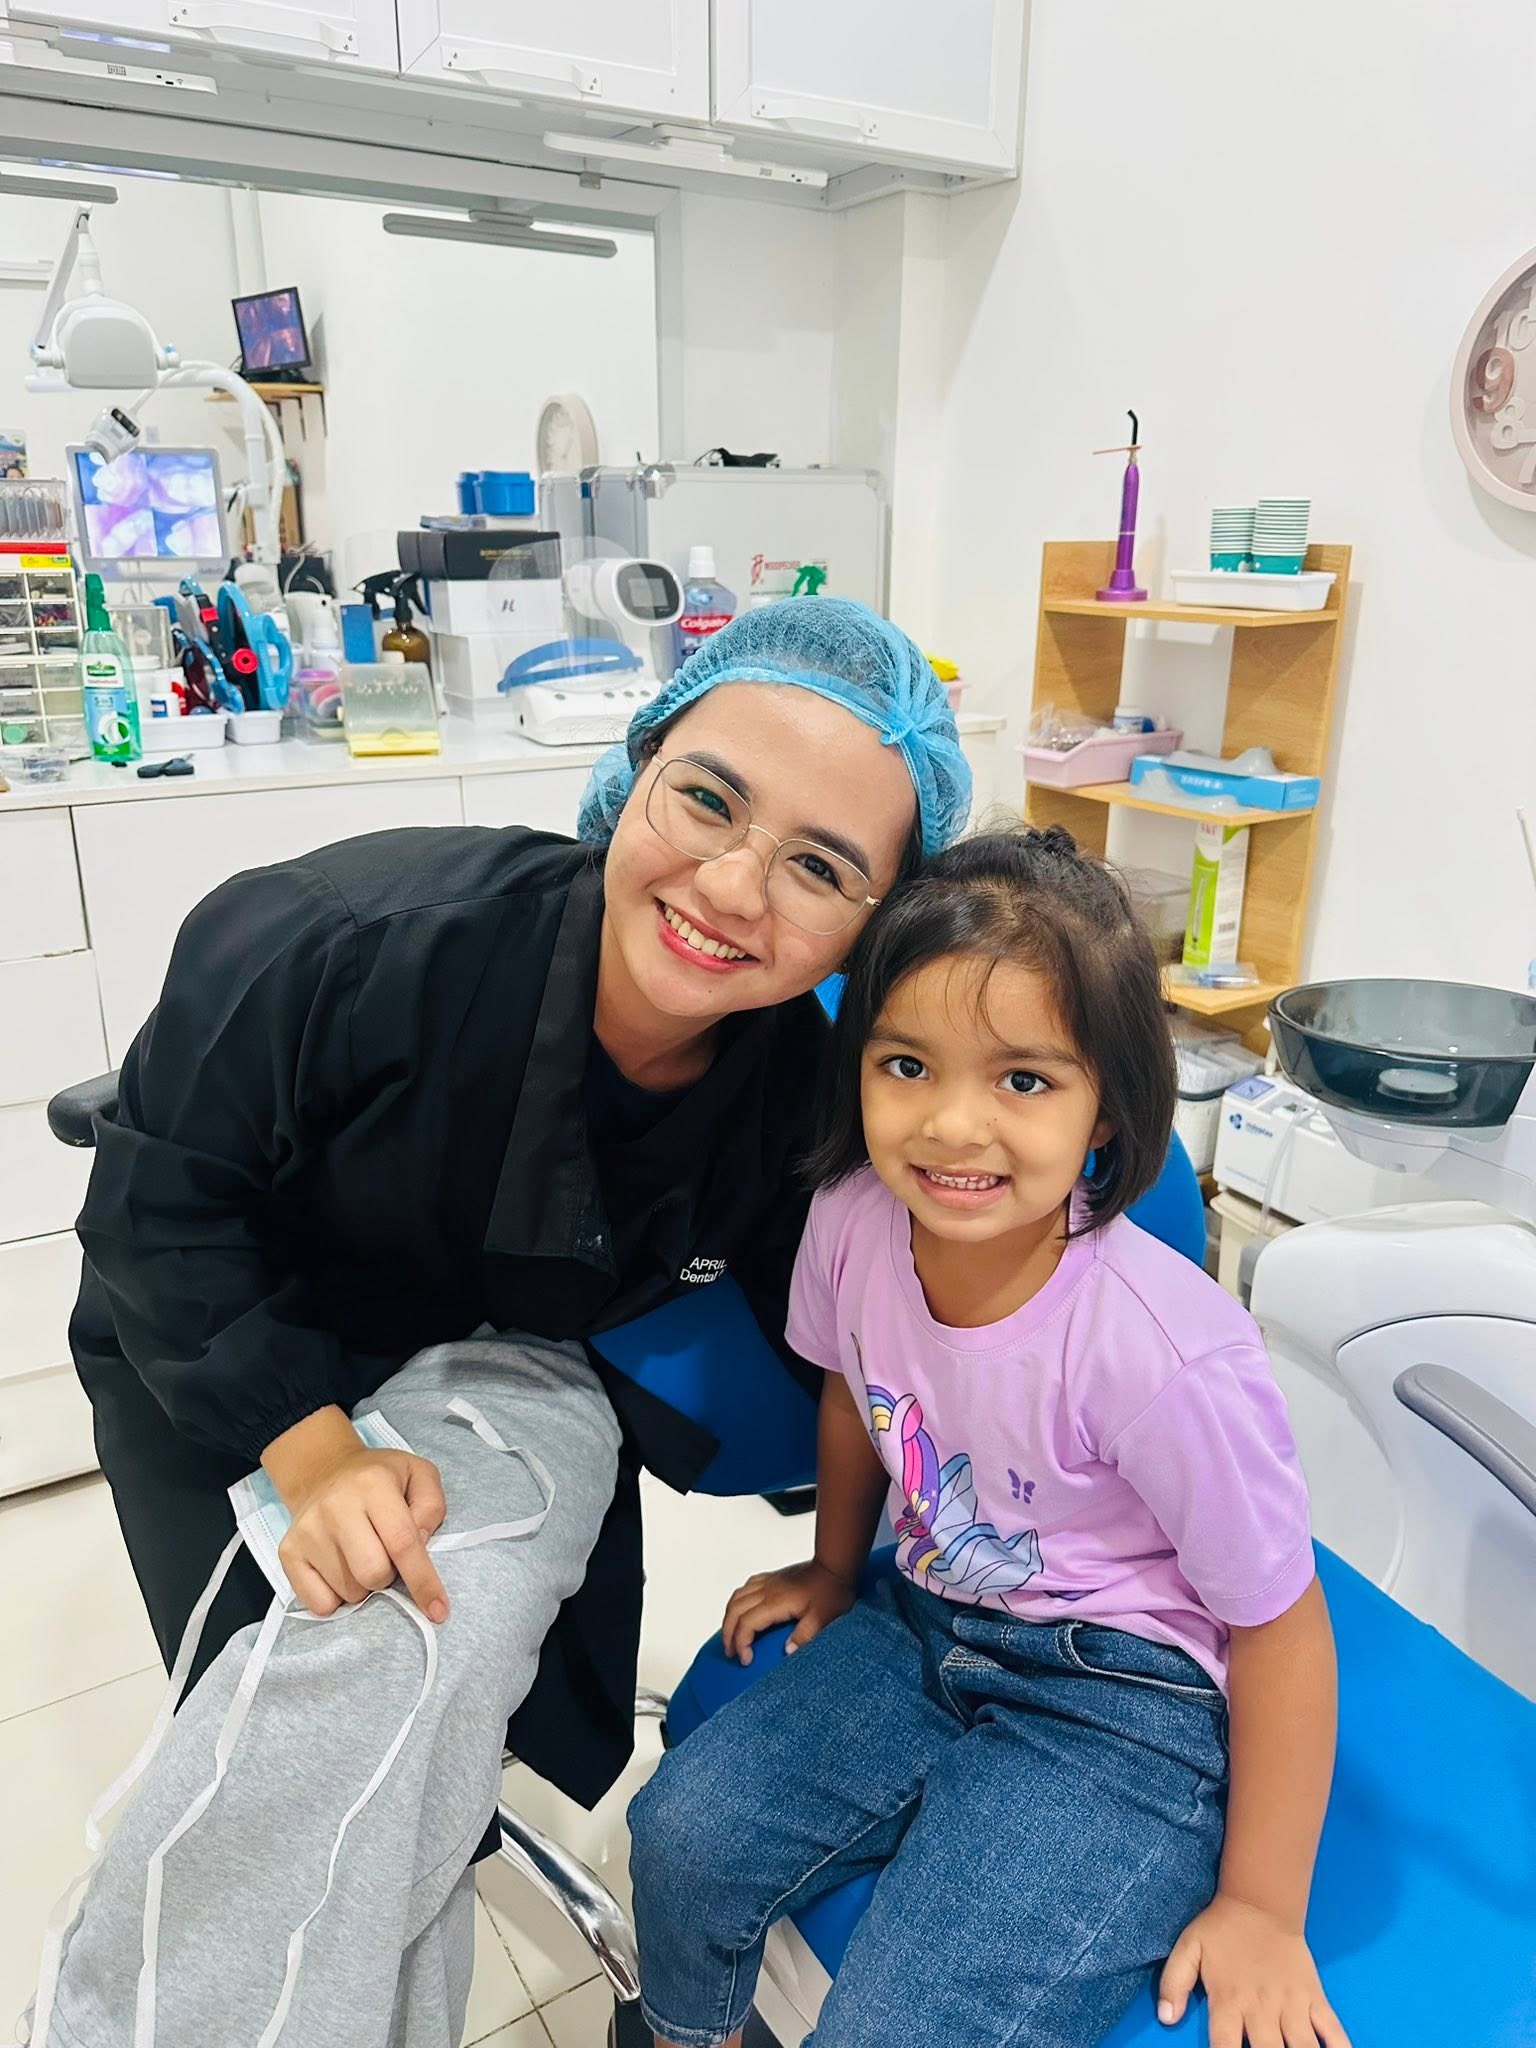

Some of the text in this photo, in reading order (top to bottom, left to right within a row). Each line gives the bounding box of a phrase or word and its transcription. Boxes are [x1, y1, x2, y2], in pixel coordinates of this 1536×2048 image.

[1472, 346, 1515, 413] 9
[680, 617, 729, 631] Colgate
[680, 1268, 719, 1284] Dental
